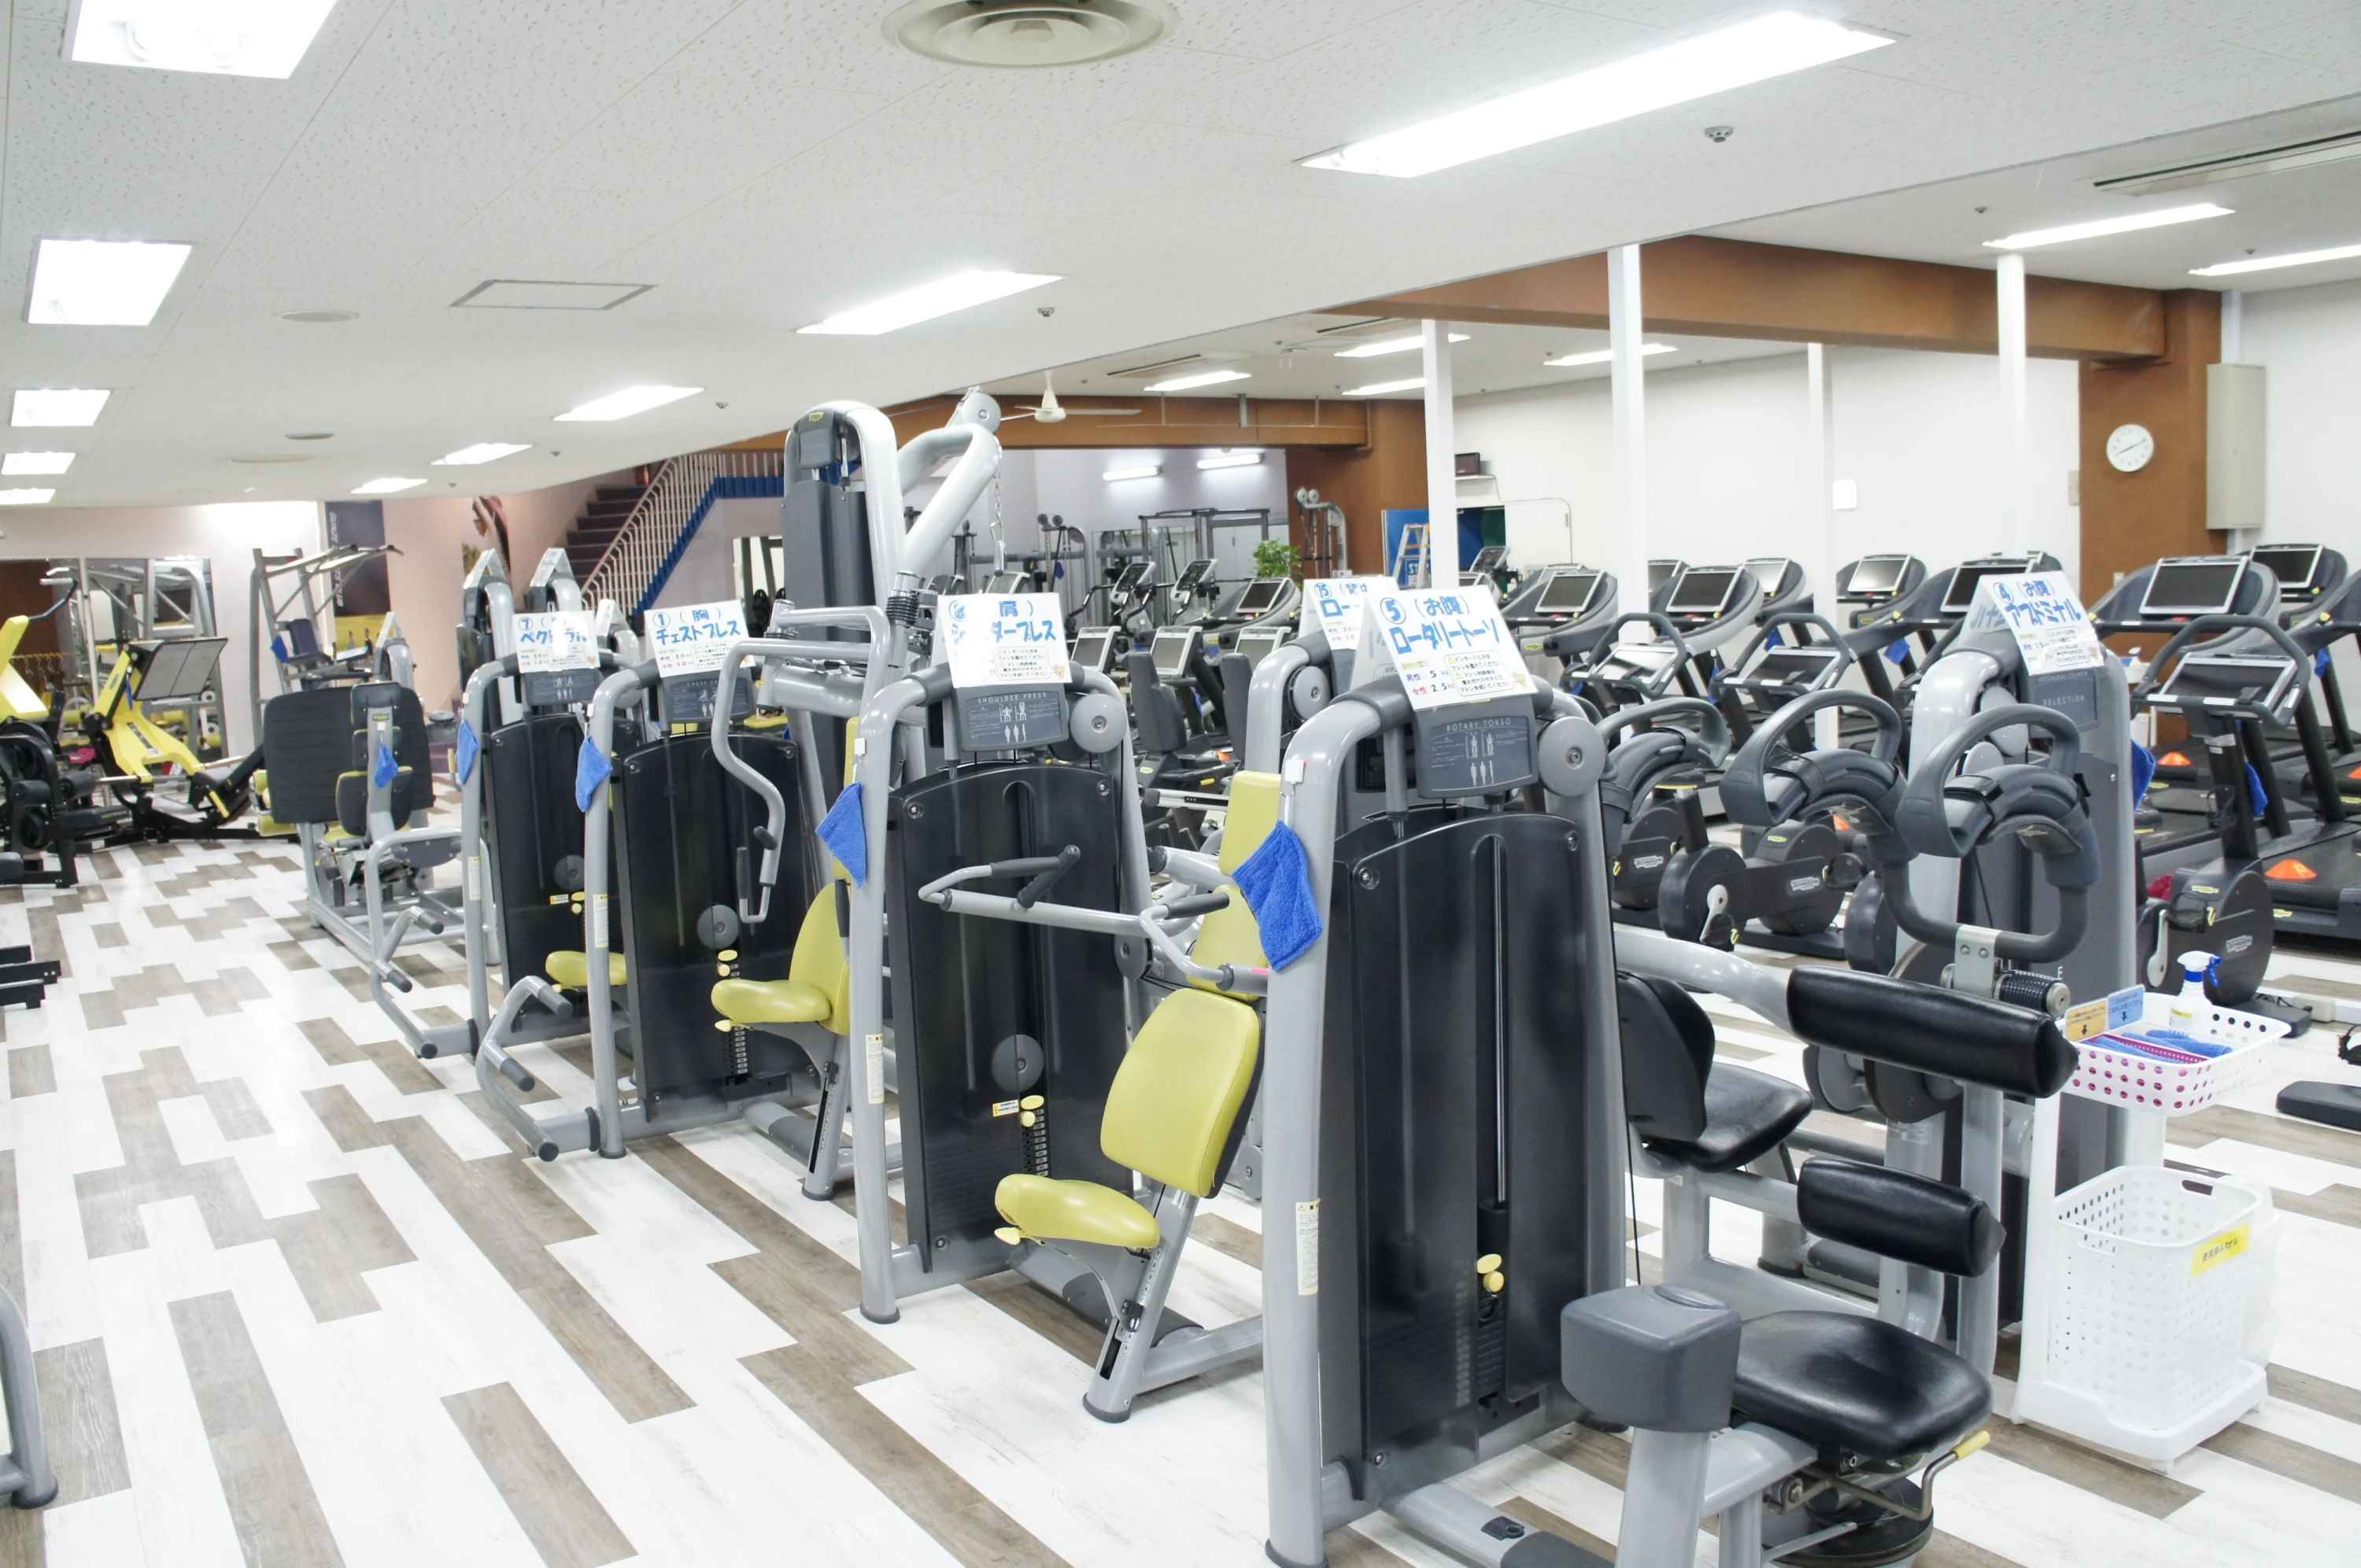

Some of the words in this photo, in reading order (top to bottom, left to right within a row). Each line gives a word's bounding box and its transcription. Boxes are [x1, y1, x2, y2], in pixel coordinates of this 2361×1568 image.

[2004, 598, 2082, 628] アブドミナル
[656, 620, 741, 645] チェストプレス
[977, 695, 1018, 704] SHOULDER
[2043, 695, 2085, 706] SELECTION
[1447, 722, 1478, 732] ROTARY
[1483, 718, 1511, 728] TORSO
